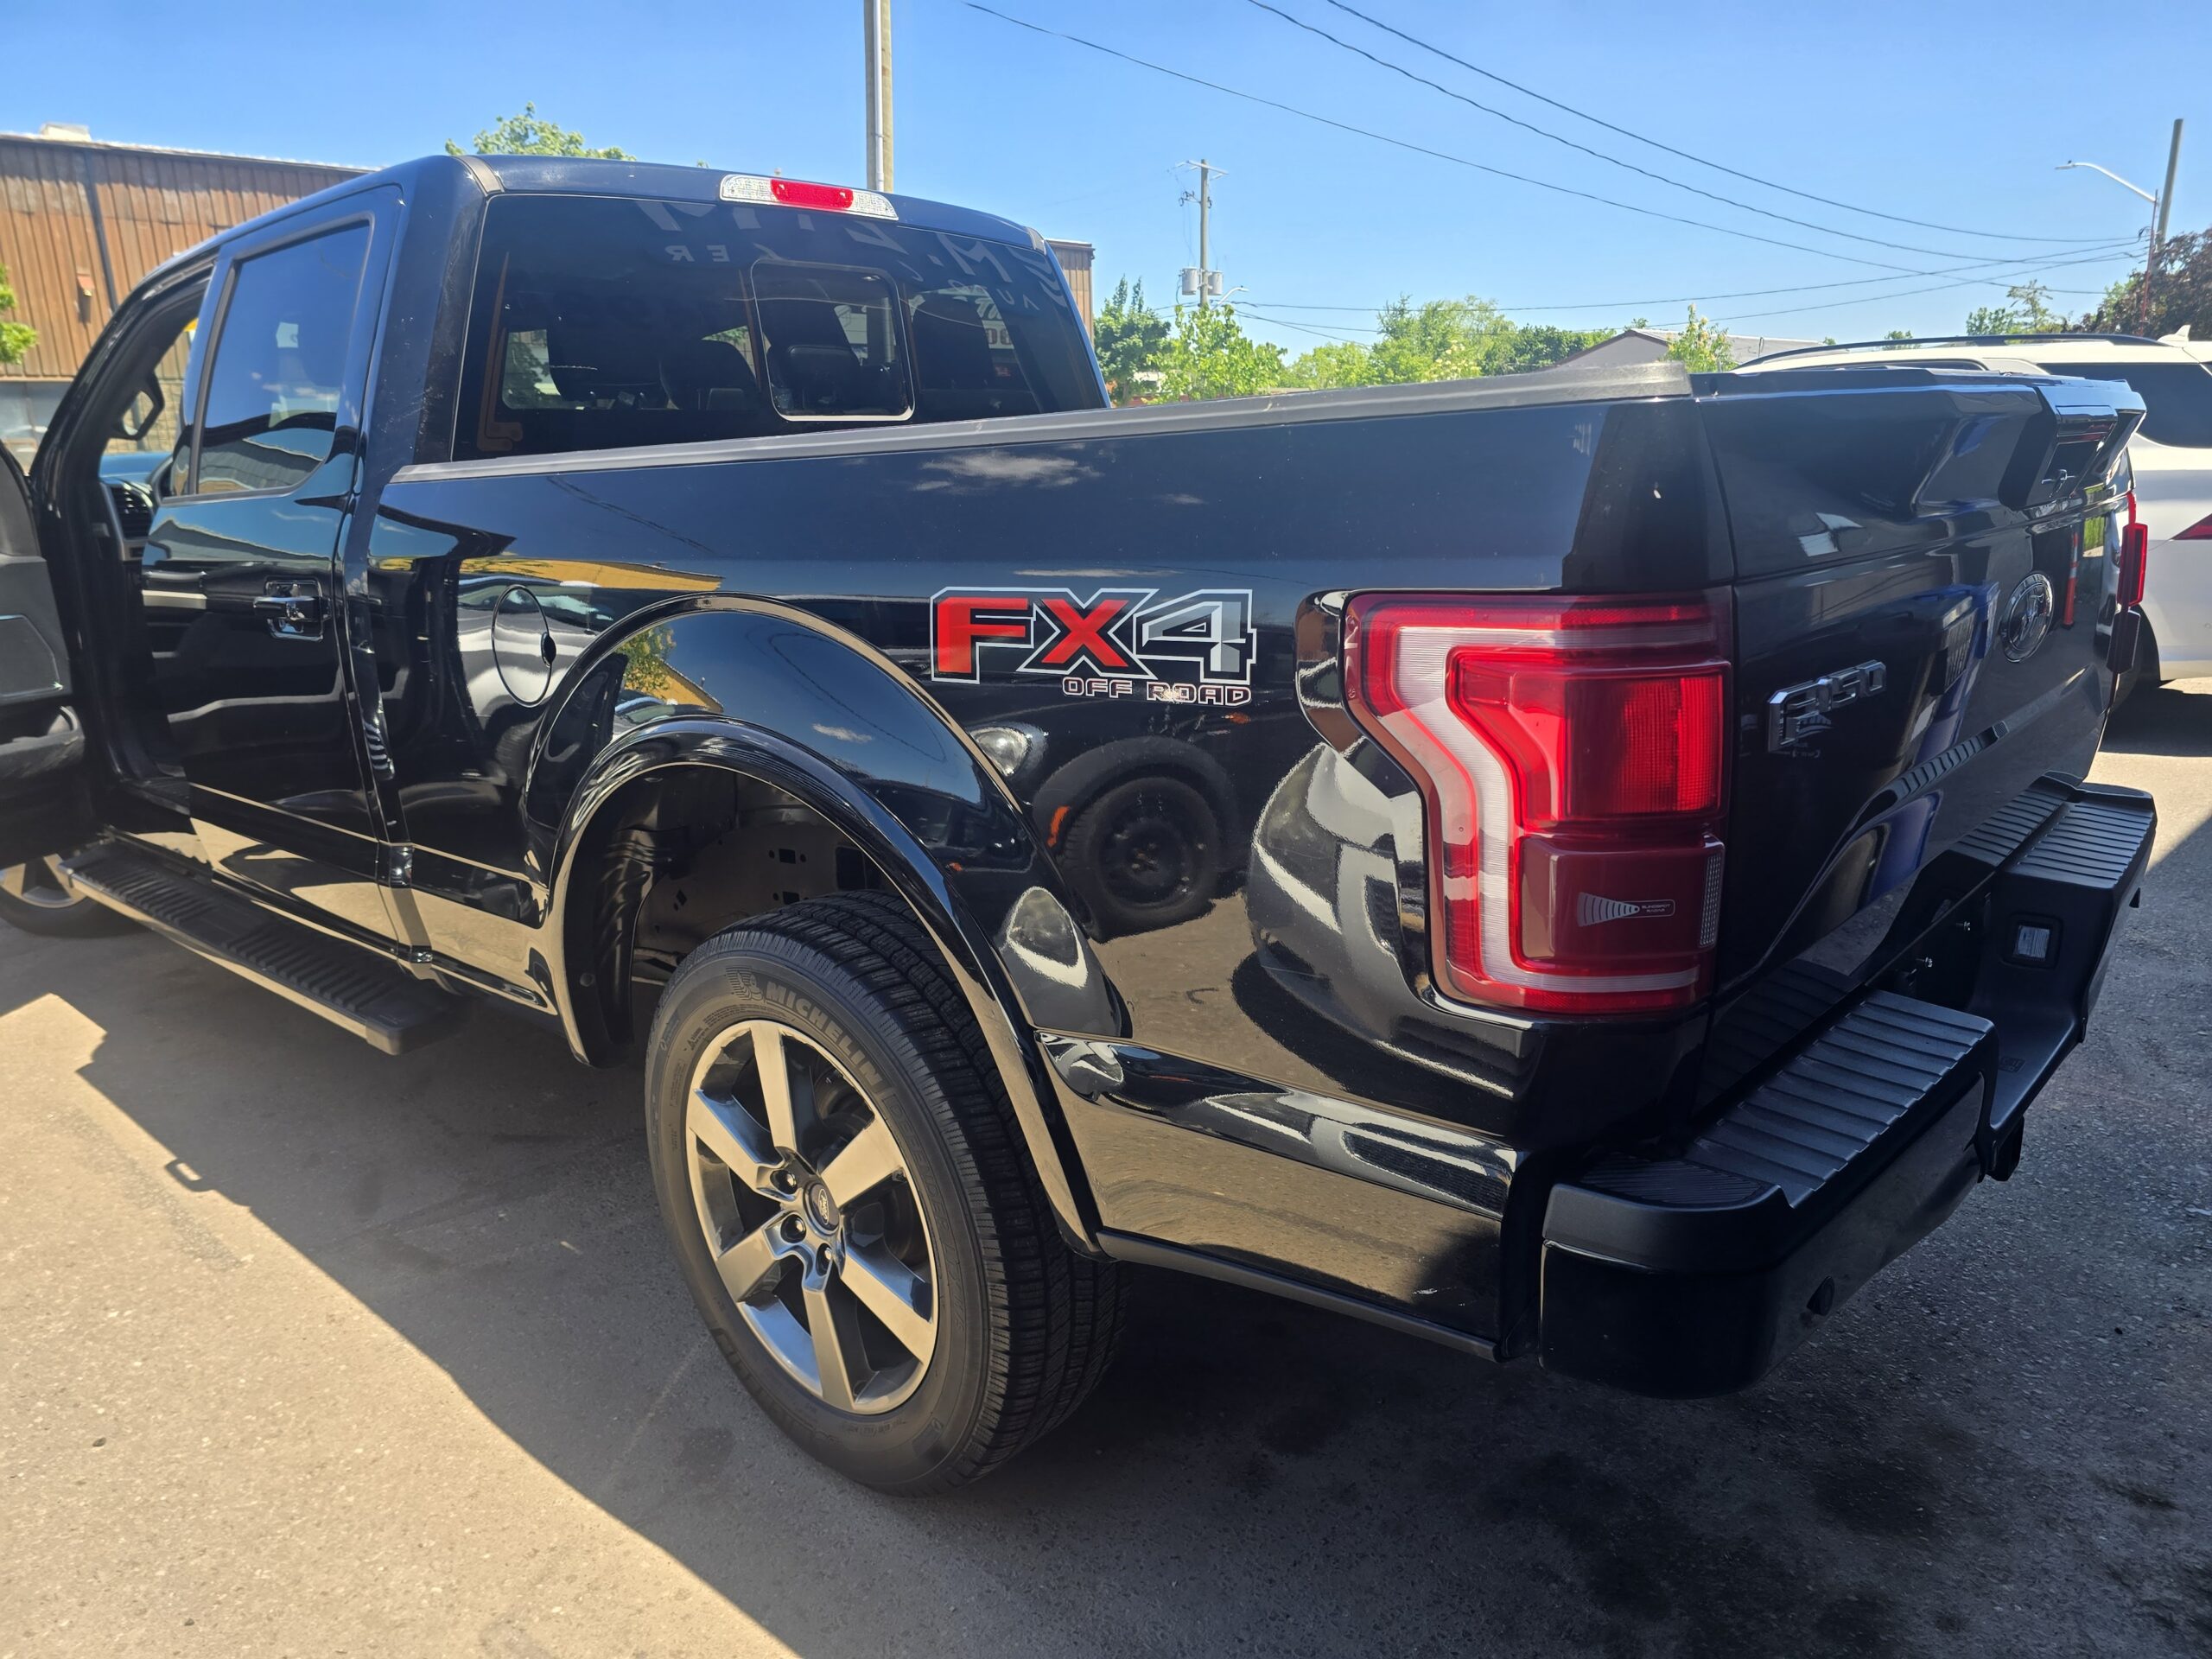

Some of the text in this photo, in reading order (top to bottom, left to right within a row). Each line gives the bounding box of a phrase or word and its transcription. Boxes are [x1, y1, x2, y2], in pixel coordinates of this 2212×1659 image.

[930, 587, 1256, 684] FX4
[1063, 677, 1252, 706] OFF ROAD
[766, 981, 883, 1086] MICHELIN
